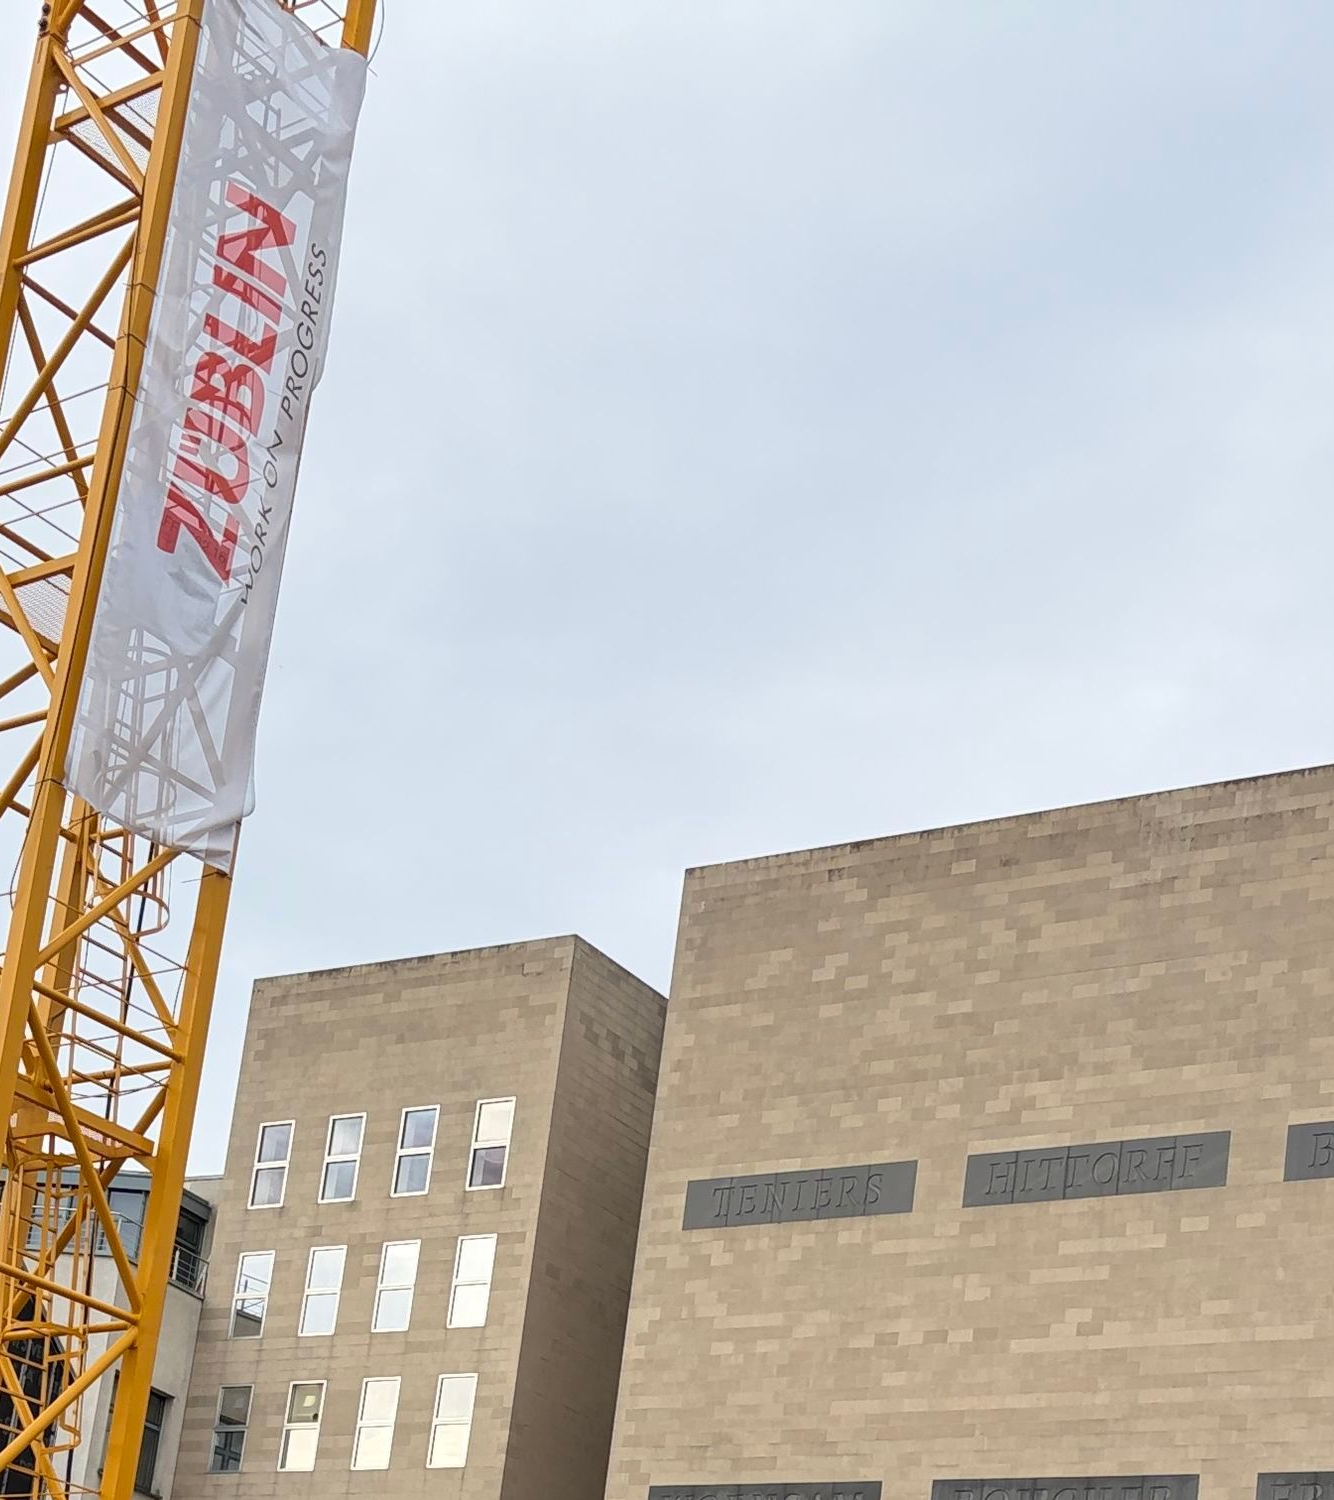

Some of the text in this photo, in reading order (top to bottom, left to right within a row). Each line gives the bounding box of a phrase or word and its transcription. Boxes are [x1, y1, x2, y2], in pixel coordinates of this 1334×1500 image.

[156, 180, 297, 588] ZÜBLIN
[241, 242, 326, 604] WORK ON PROGRESS
[712, 1172, 884, 1221] TENIERS
[984, 1142, 1203, 1197] HITTORFF
